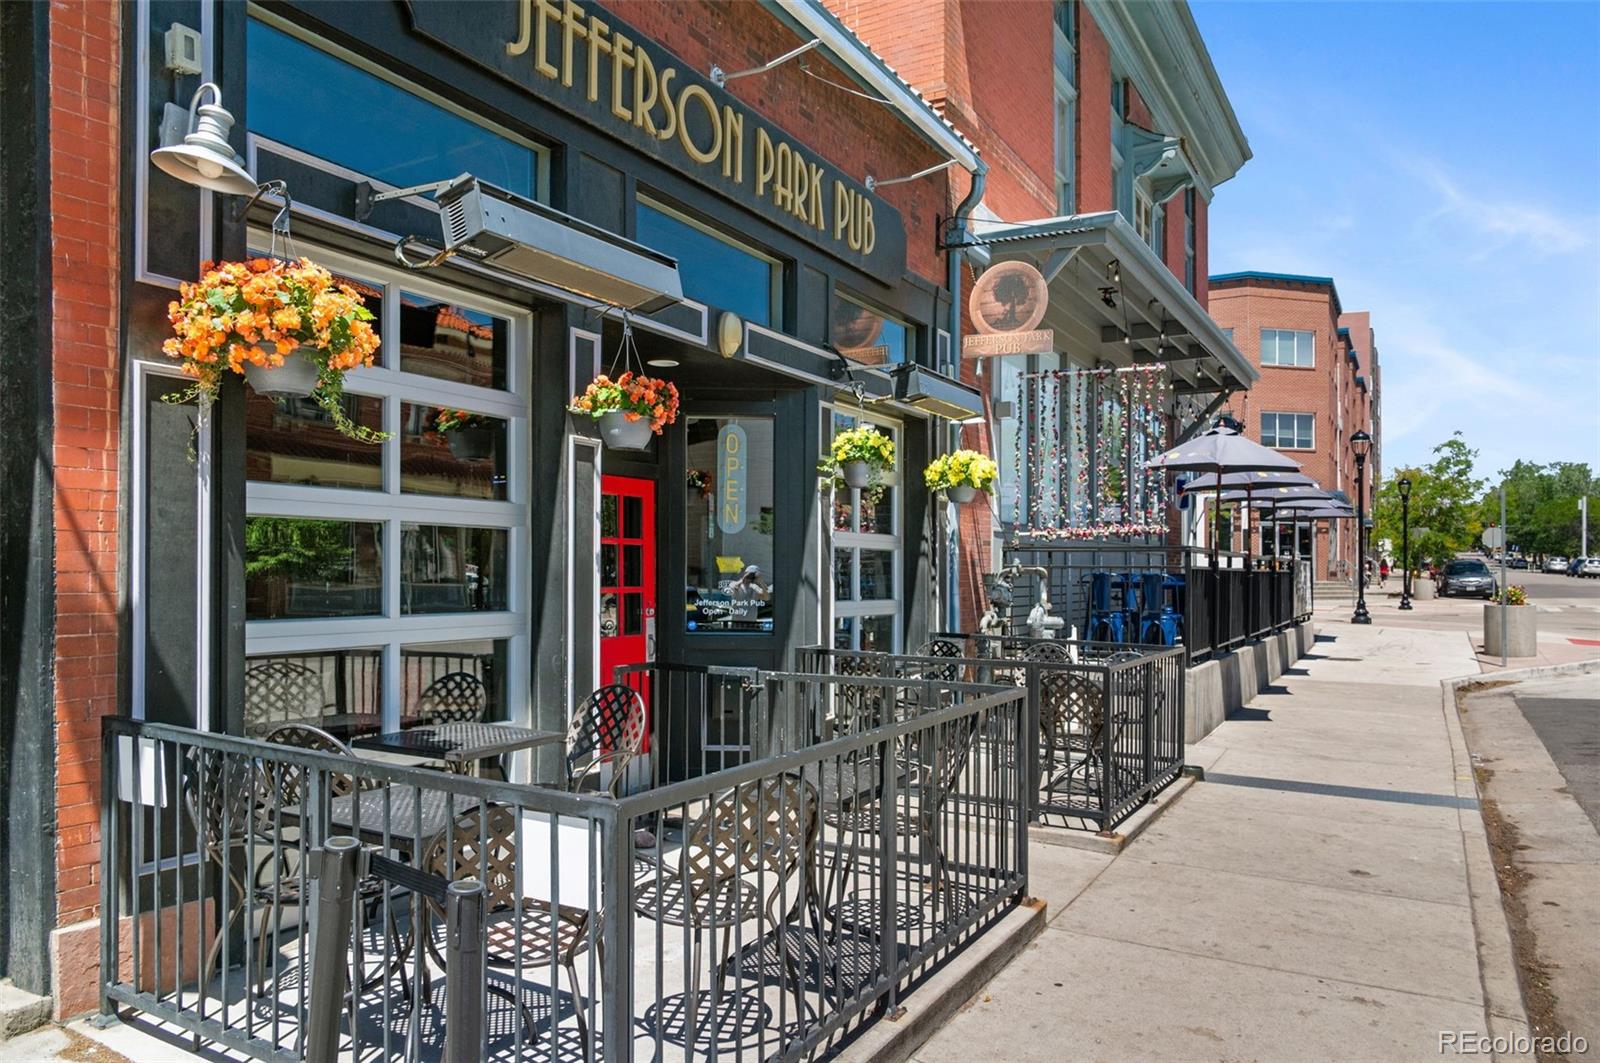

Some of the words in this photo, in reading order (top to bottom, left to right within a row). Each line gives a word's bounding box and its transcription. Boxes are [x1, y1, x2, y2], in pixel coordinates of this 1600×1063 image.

[506, 0, 744, 184] JEFFERSON
[756, 127, 825, 231] PARK
[834, 180, 876, 255] PUB
[995, 343, 1021, 354] PUB
[725, 433, 739, 524] OPEN
[702, 607, 723, 615] Open
[728, 607, 748, 616] Daily
